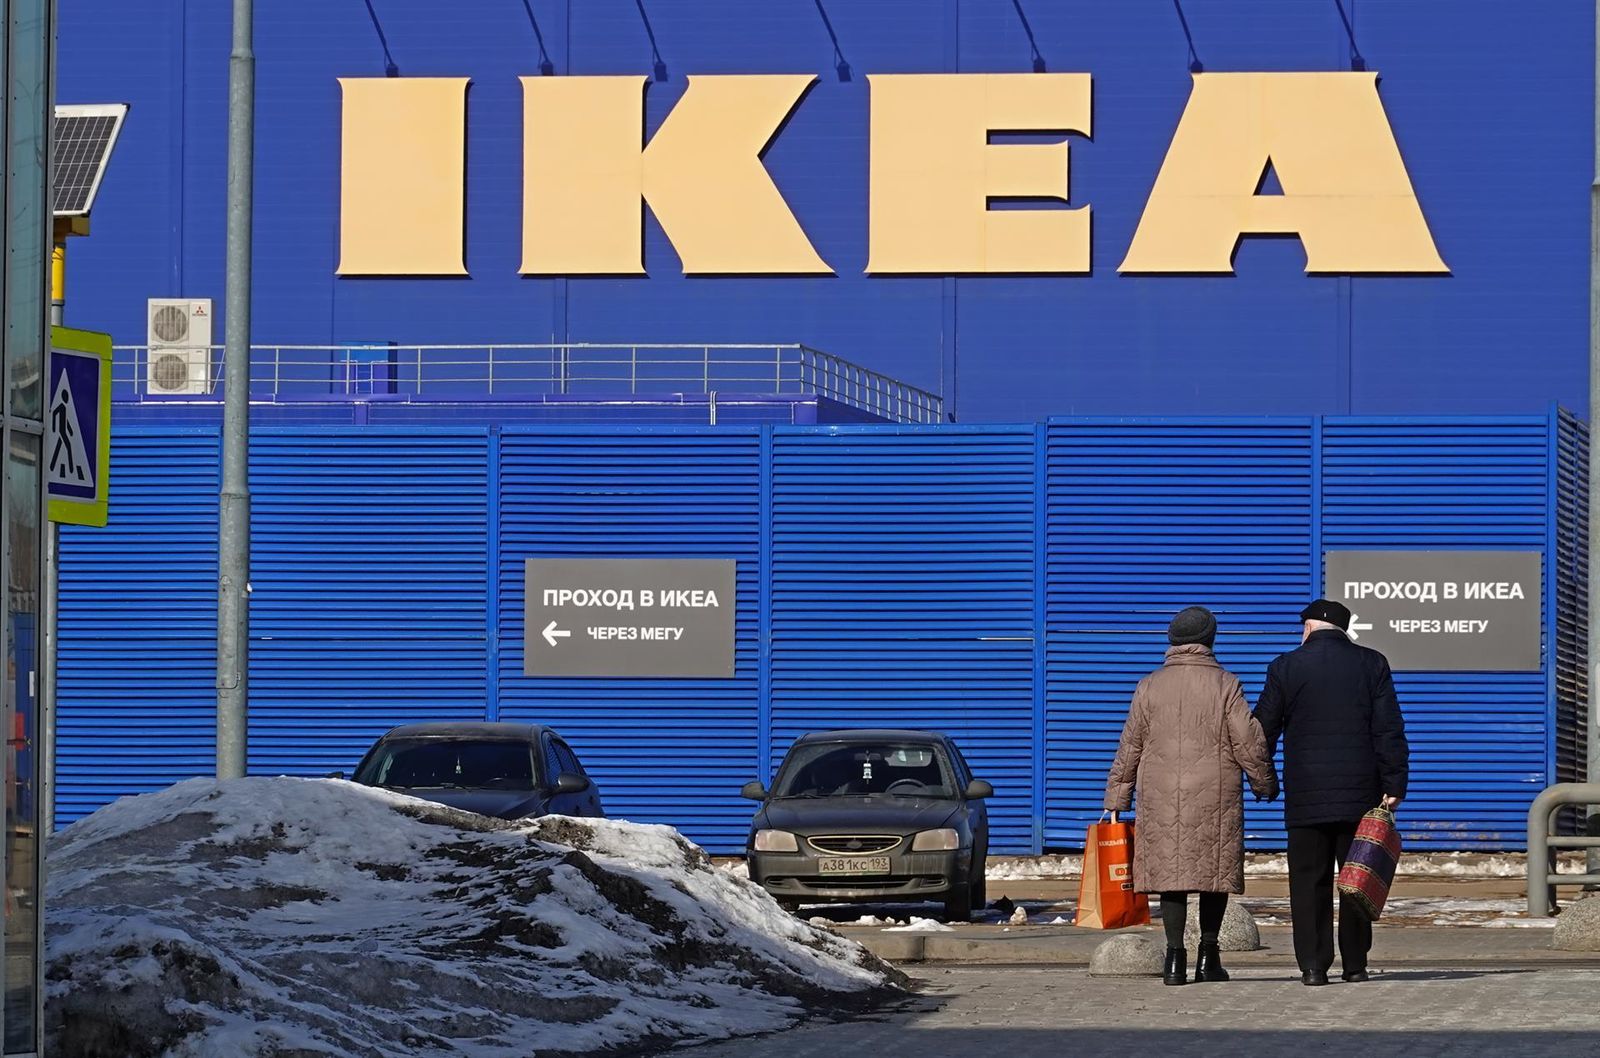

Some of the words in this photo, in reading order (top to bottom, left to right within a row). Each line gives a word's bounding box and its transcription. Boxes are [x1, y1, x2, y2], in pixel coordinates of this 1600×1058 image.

[336, 71, 1451, 277] IKEA
[543, 588, 635, 611] ПРОХОД
[639, 589, 655, 608] В
[660, 589, 720, 608] ИКЕА
[1344, 581, 1438, 604] ПРОХОД
[1443, 581, 1459, 600] В
[1464, 581, 1525, 600] ИКЕА
[586, 626, 638, 641] ЧЕРЕЗ
[640, 626, 684, 641] МЕГУ
[1389, 619, 1442, 634] ЧЕРЕЗ
[1444, 619, 1489, 634] МЕГУ
